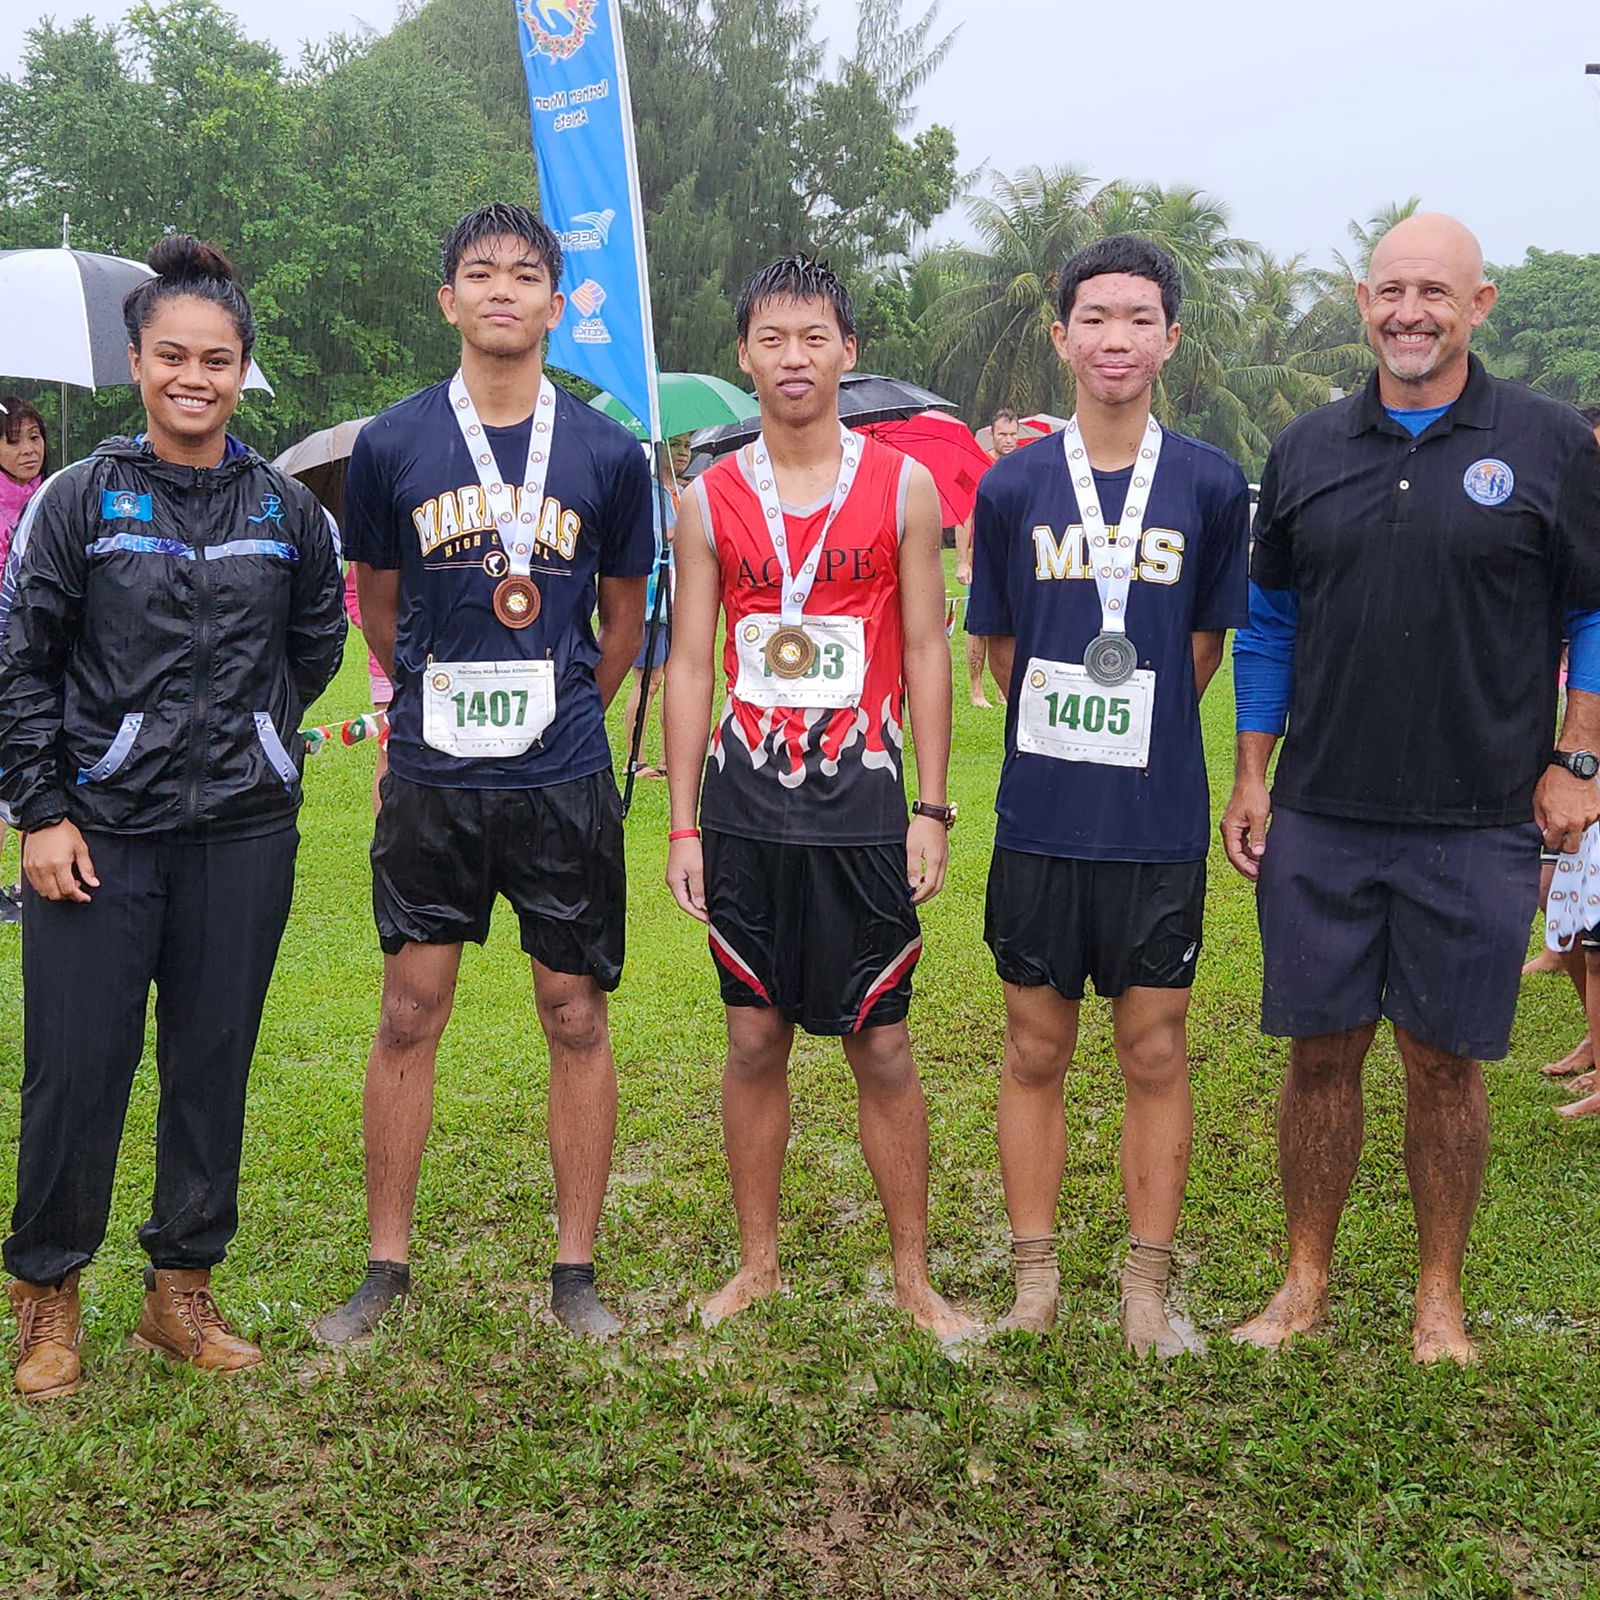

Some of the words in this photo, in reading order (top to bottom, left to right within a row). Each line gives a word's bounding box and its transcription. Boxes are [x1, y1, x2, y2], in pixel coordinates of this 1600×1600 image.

[412, 484, 582, 560] MARAS
[444, 534, 481, 558] HIGH
[491, 534, 550, 561] SOL
[738, 547, 877, 588] AGPE
[1032, 524, 1184, 585] MS
[759, 642, 845, 680] 103
[451, 690, 528, 727] 1407
[1045, 691, 1131, 735] 1405
